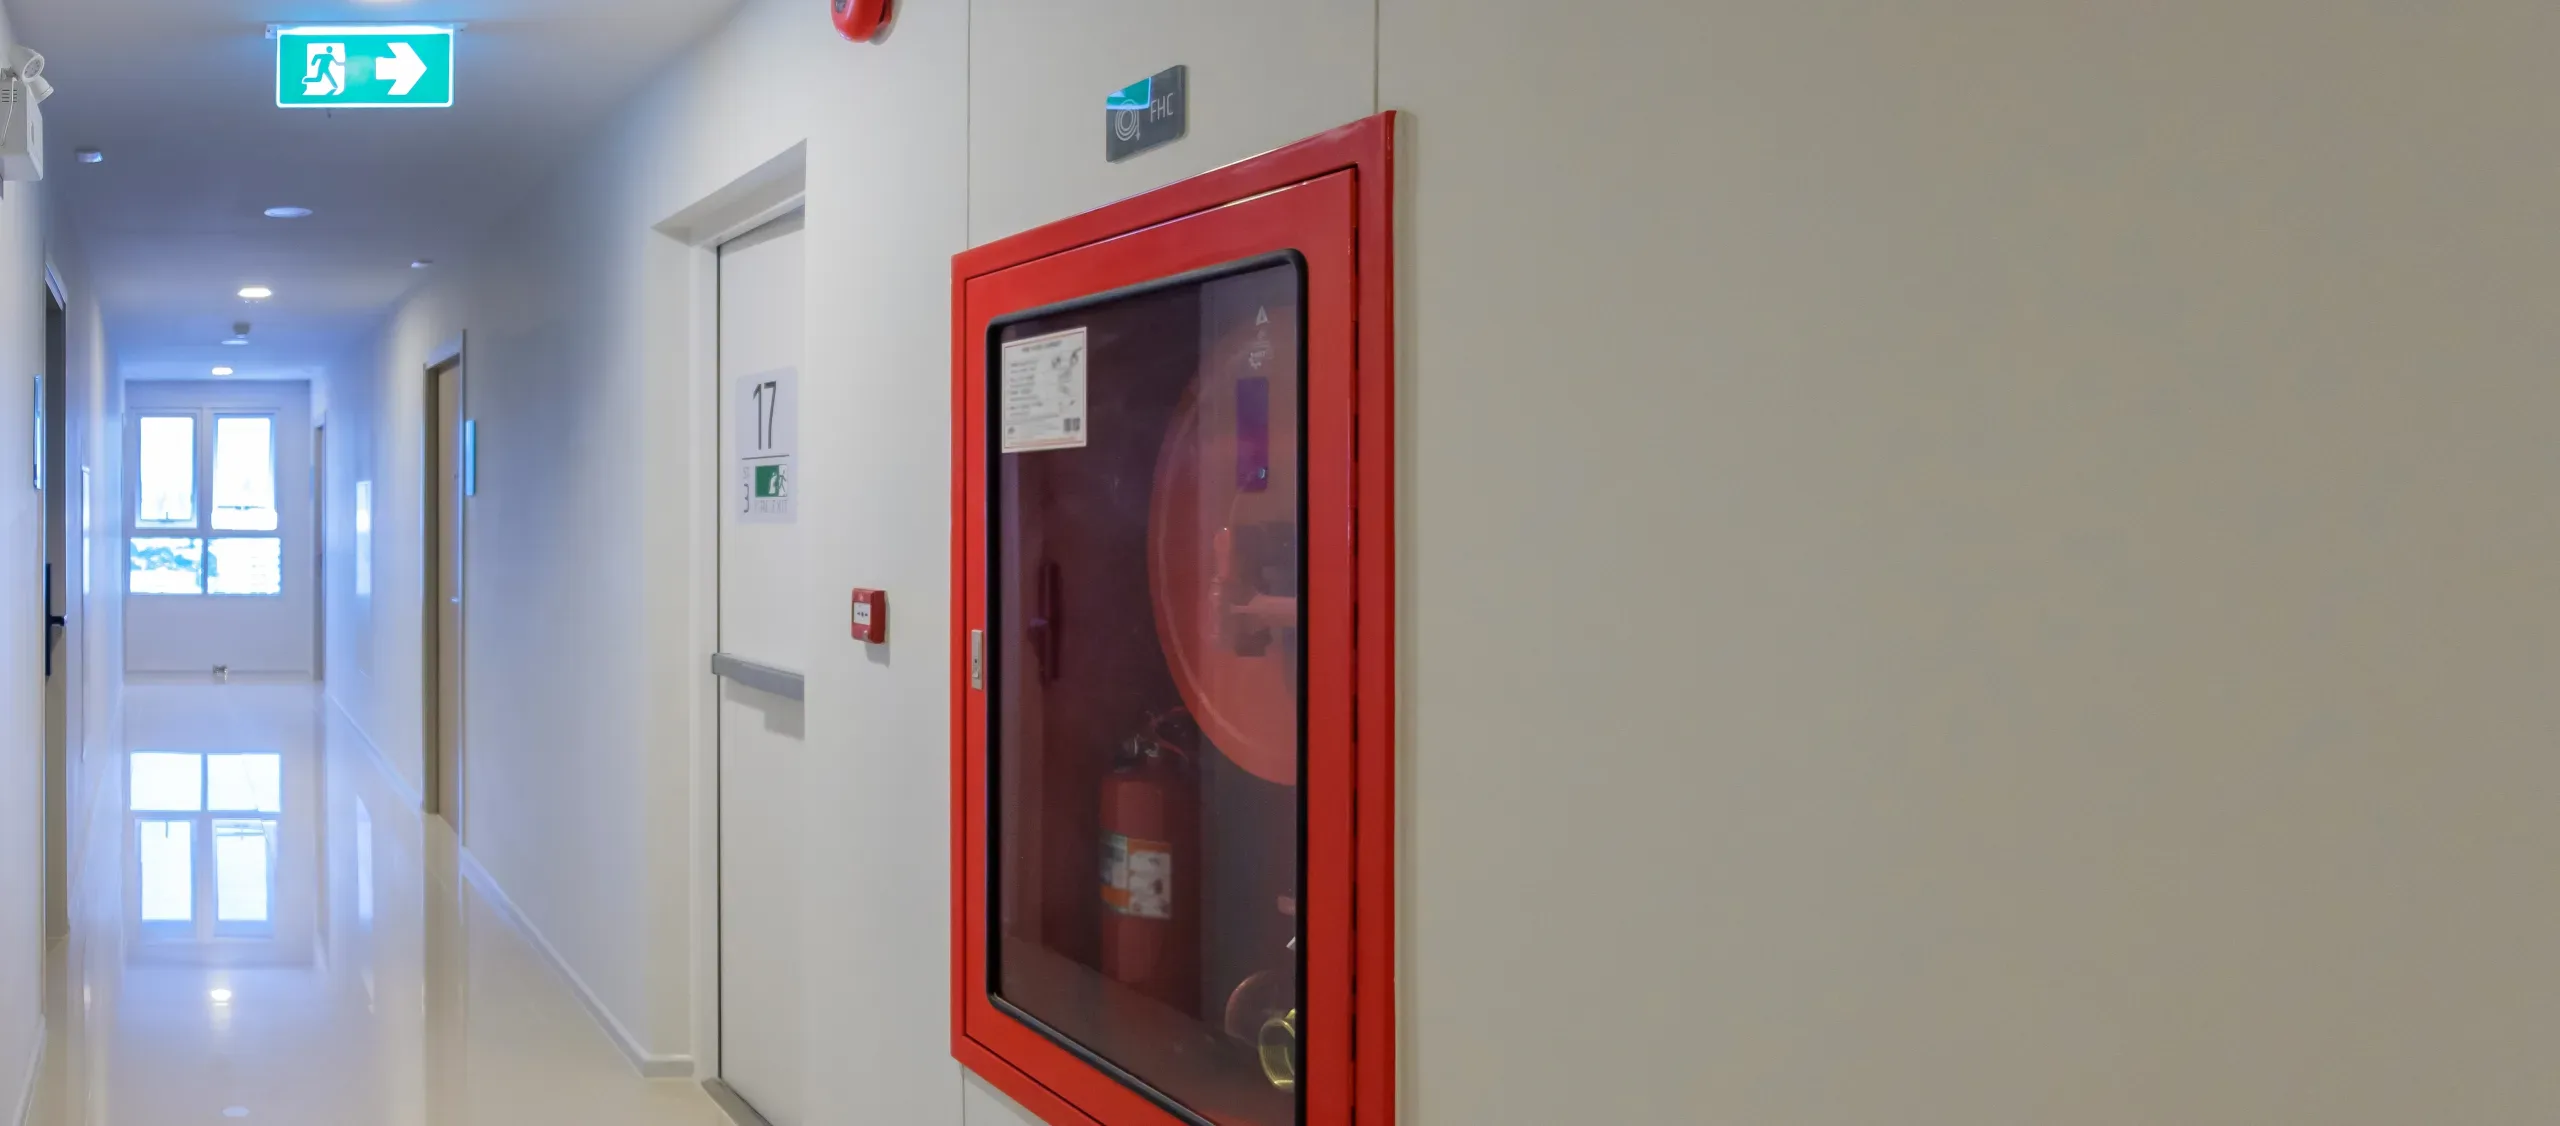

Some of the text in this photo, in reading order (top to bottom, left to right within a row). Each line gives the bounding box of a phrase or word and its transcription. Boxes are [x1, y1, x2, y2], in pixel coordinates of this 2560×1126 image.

[1150, 92, 1174, 123] FHC
[752, 380, 777, 451] 17
[743, 483, 750, 513] 3
